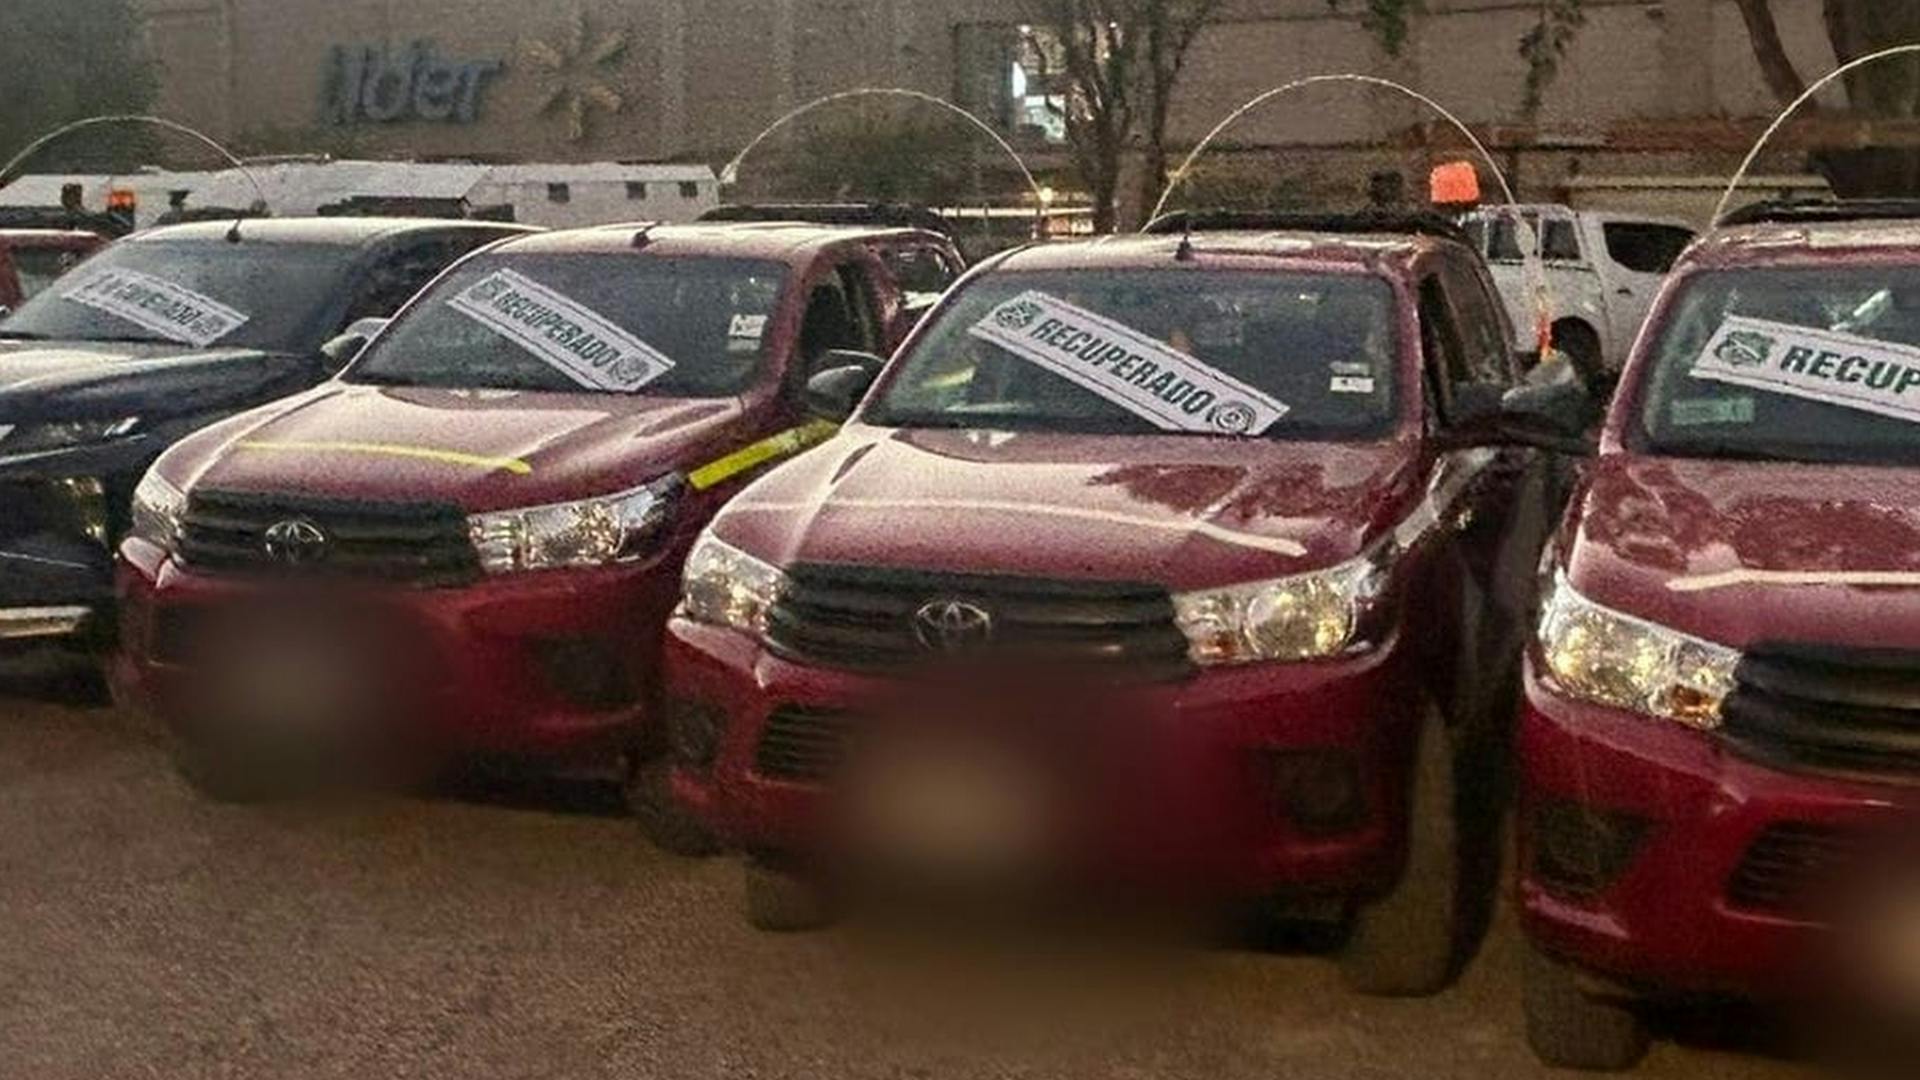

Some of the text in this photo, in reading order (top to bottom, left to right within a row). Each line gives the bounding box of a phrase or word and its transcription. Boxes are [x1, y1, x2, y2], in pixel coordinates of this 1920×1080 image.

[493, 289, 622, 368] RECUPERADO
[1029, 317, 1217, 415] RECUPERADO
[1779, 345, 1920, 394] RECUP
